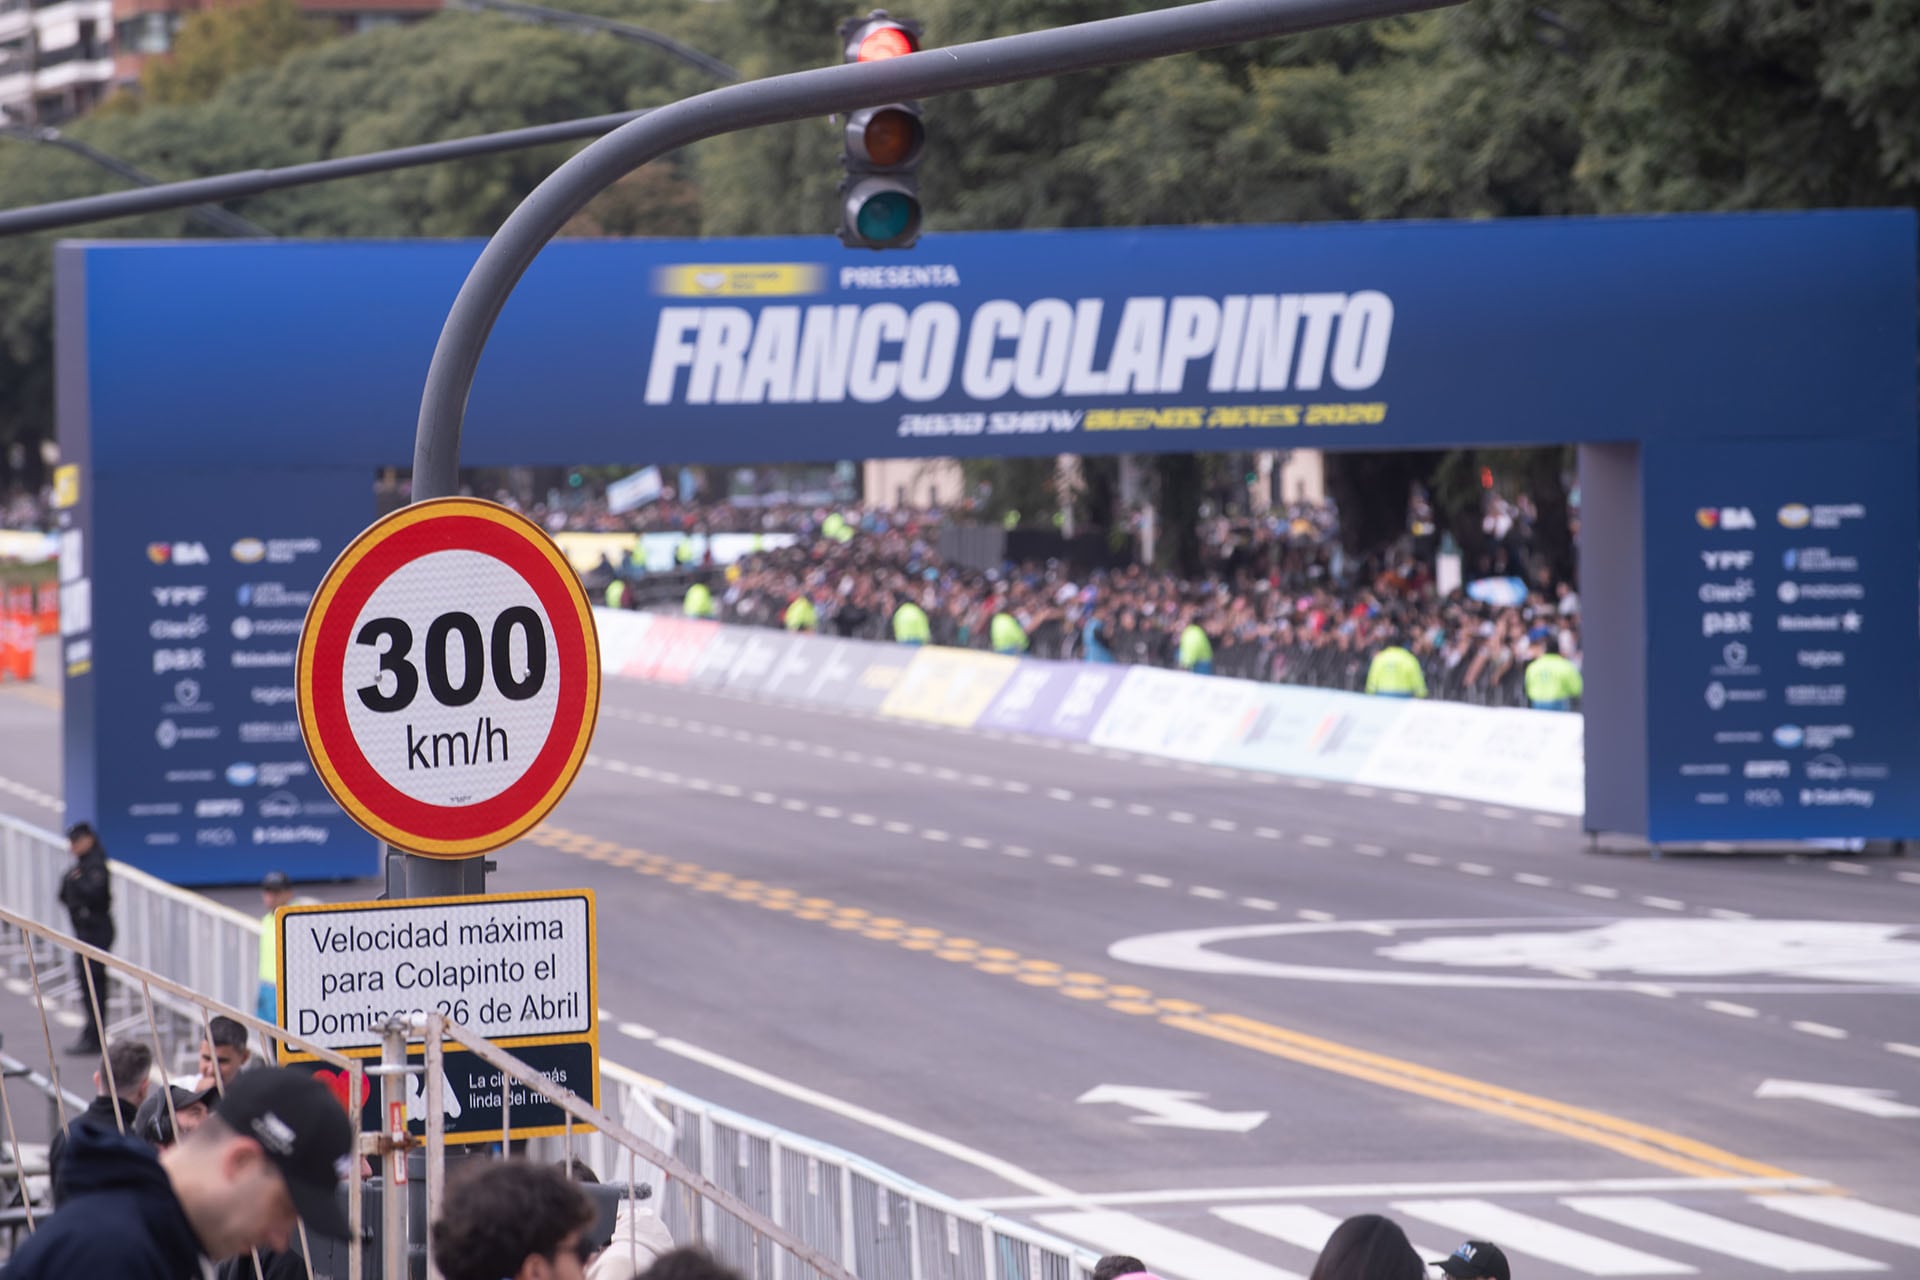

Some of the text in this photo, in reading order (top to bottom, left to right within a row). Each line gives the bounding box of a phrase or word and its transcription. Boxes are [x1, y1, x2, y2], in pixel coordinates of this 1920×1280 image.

[840, 265, 960, 289] PRESENTA
[644, 290, 1395, 405] FRANCO COLAPINTO
[986, 410, 1084, 435] SHOW
[1082, 407, 1205, 431] BUENOS
[1206, 405, 1302, 428] AIRES
[1701, 550, 1754, 571] YPF
[356, 605, 547, 713] 300
[406, 717, 509, 770] km/h
[311, 915, 564, 953] Velocidad máxima
[322, 954, 557, 1000] para Colapinto el
[299, 992, 579, 1036] Domi 26 de Abril
[469, 1073, 486, 1089] La
[469, 1091, 502, 1109] linda
[508, 1089, 526, 1106] del
